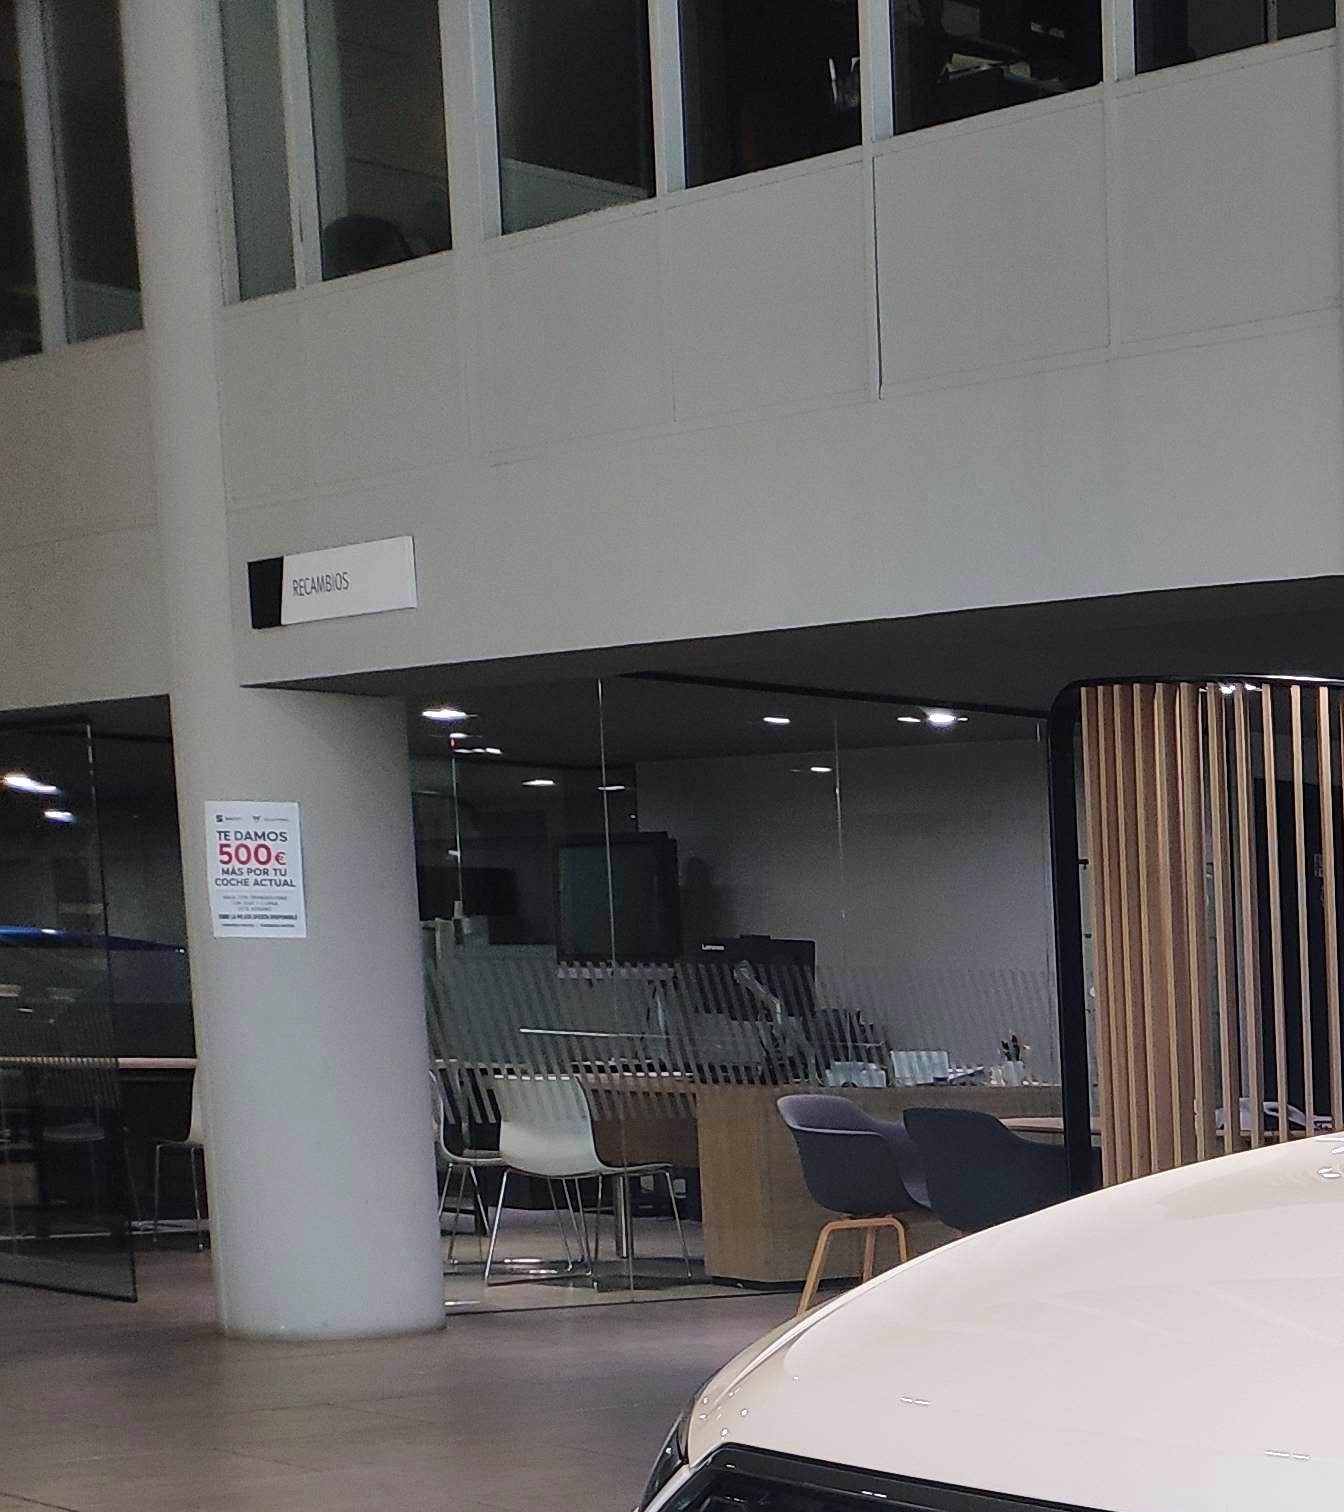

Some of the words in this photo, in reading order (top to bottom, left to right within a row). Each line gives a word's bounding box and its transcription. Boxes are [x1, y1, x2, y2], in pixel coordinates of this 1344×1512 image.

[292, 571, 349, 596] RECAMBIOS
[216, 831, 230, 841] TE
[234, 831, 288, 842] DAMOS
[219, 843, 286, 865] 500€
[246, 867, 269, 877] POR
[273, 868, 287, 877] TU
[215, 878, 249, 887] COCHE
[253, 878, 296, 888] ACTUAL
